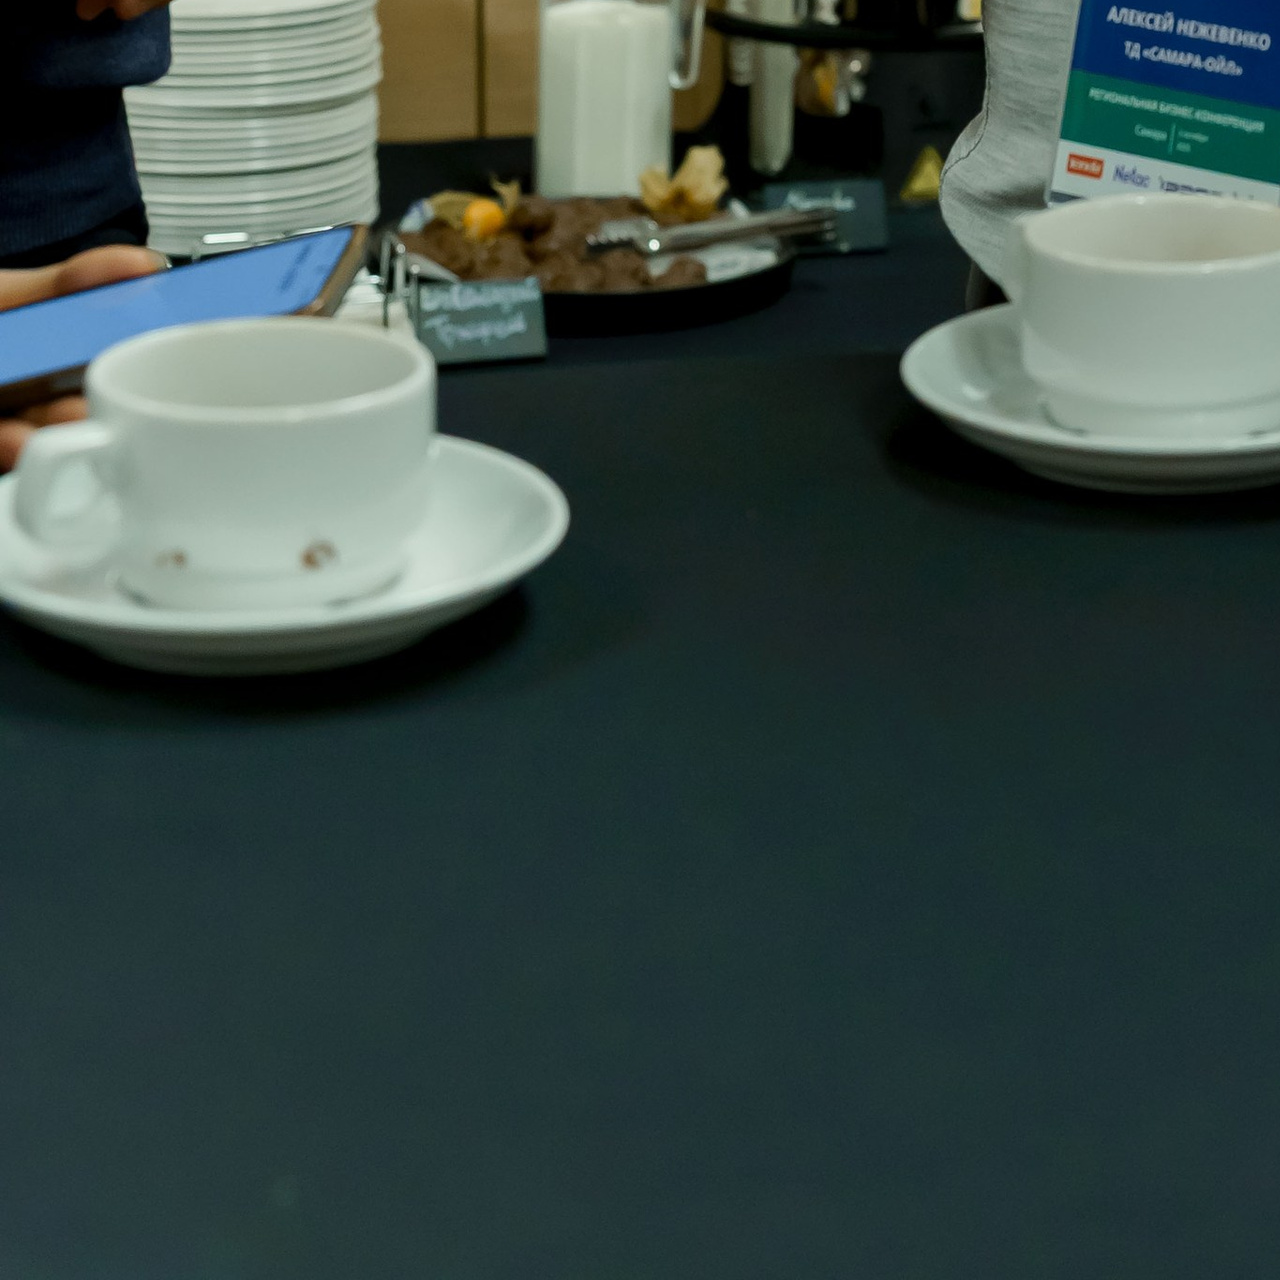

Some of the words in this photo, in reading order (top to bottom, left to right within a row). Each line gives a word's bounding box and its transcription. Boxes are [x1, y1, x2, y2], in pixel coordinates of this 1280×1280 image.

[1106, 5, 1174, 33] АЛЕКСЕЙ
[1176, 18, 1272, 51] НЕЖЕВЕНКО
[1124, 40, 1141, 61] ТД
